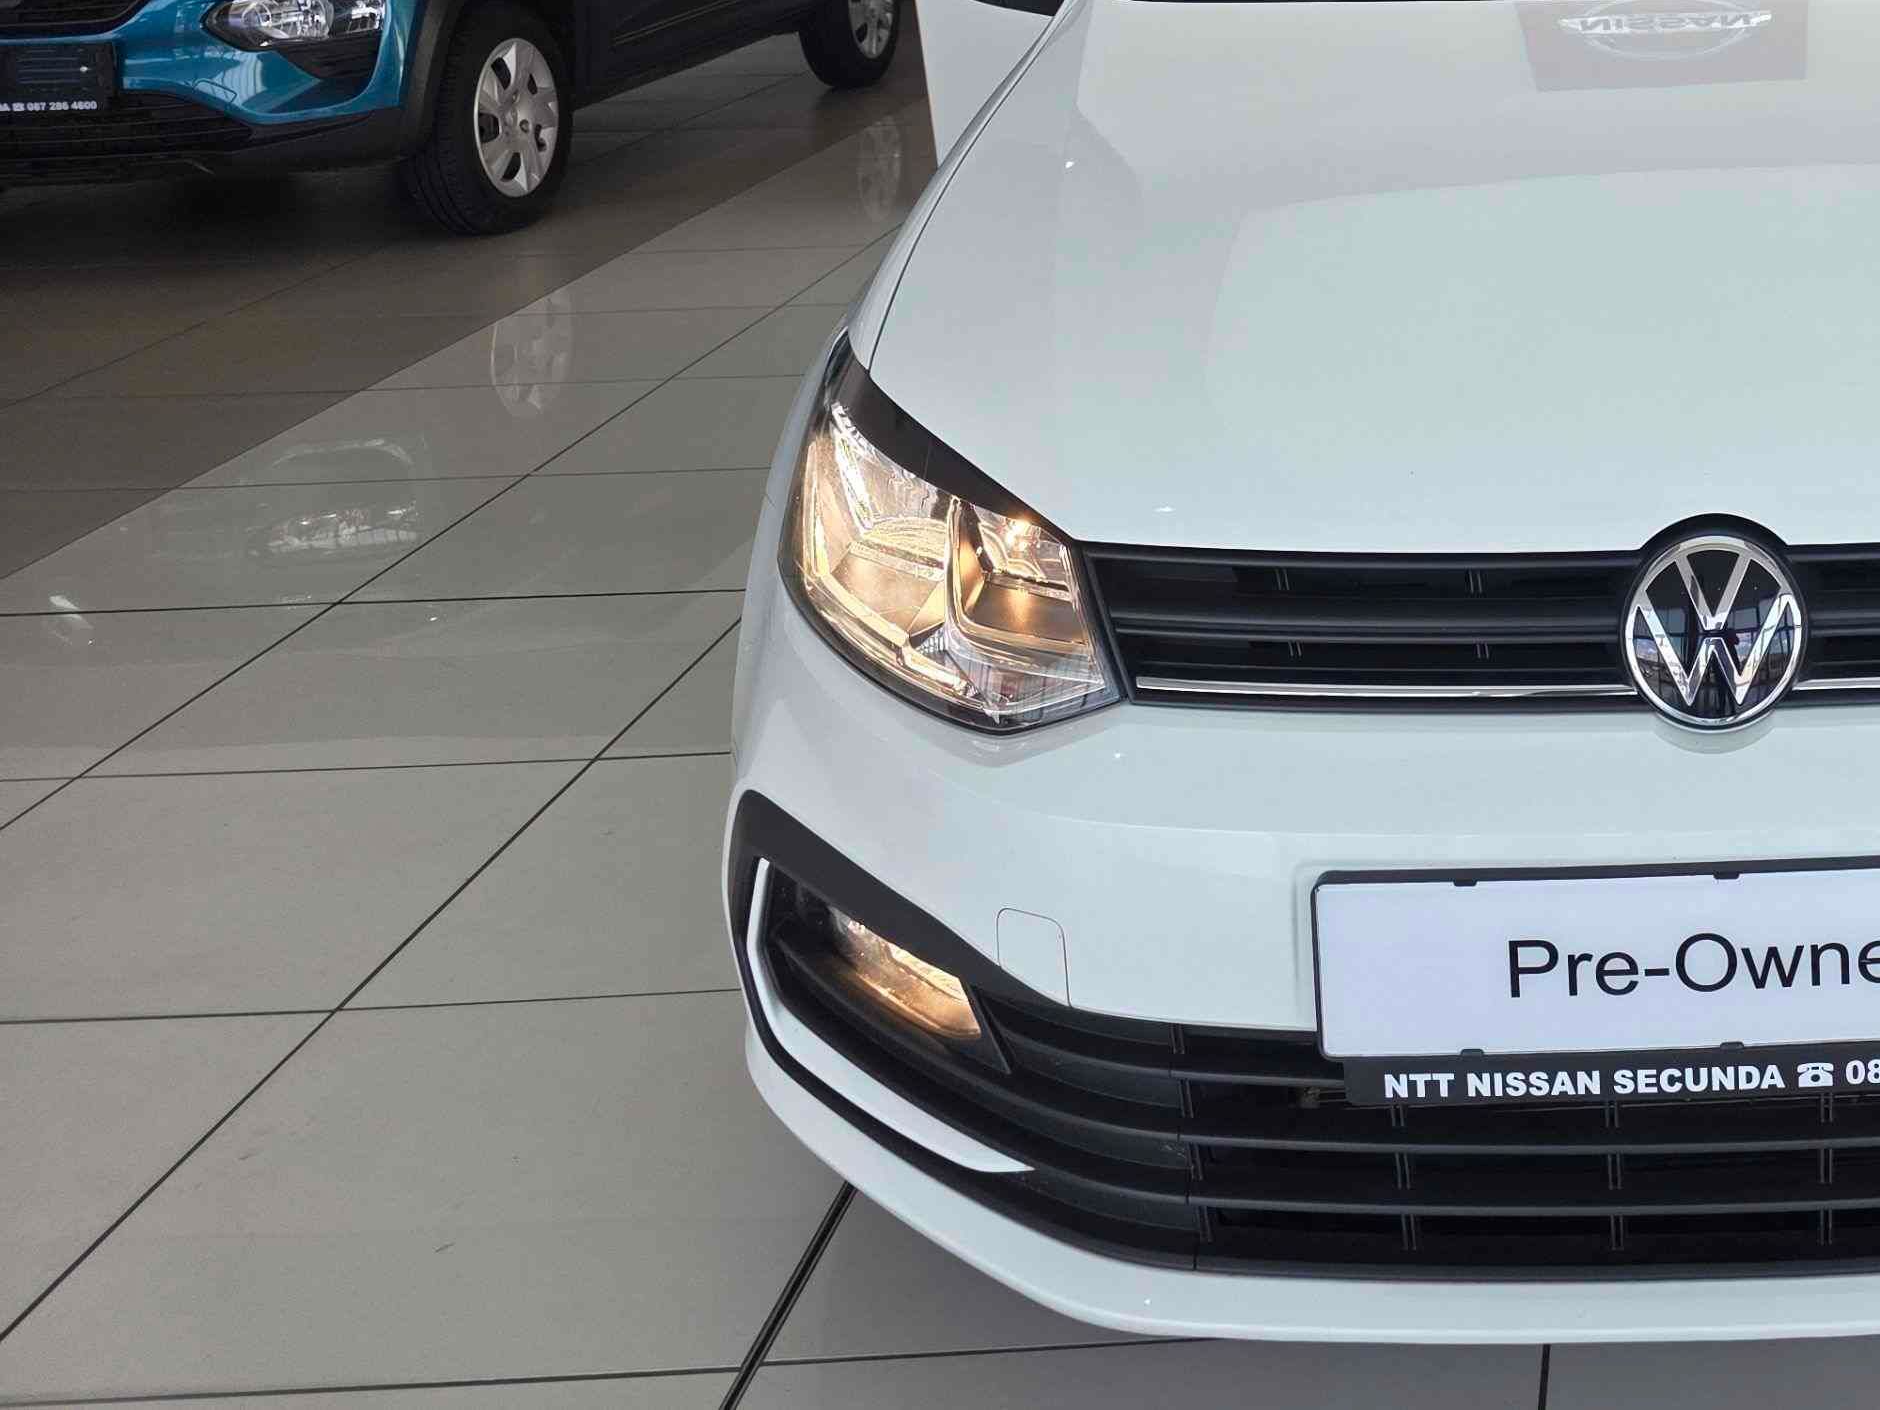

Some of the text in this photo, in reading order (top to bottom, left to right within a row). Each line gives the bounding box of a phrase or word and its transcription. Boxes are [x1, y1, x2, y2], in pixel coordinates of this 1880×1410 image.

[1627, 540, 1801, 712] VW
[1384, 1073, 1455, 1098] NTT
[1467, 1070, 1600, 1097] NISSAN
[1613, 1064, 1786, 1094] SECUNDA
